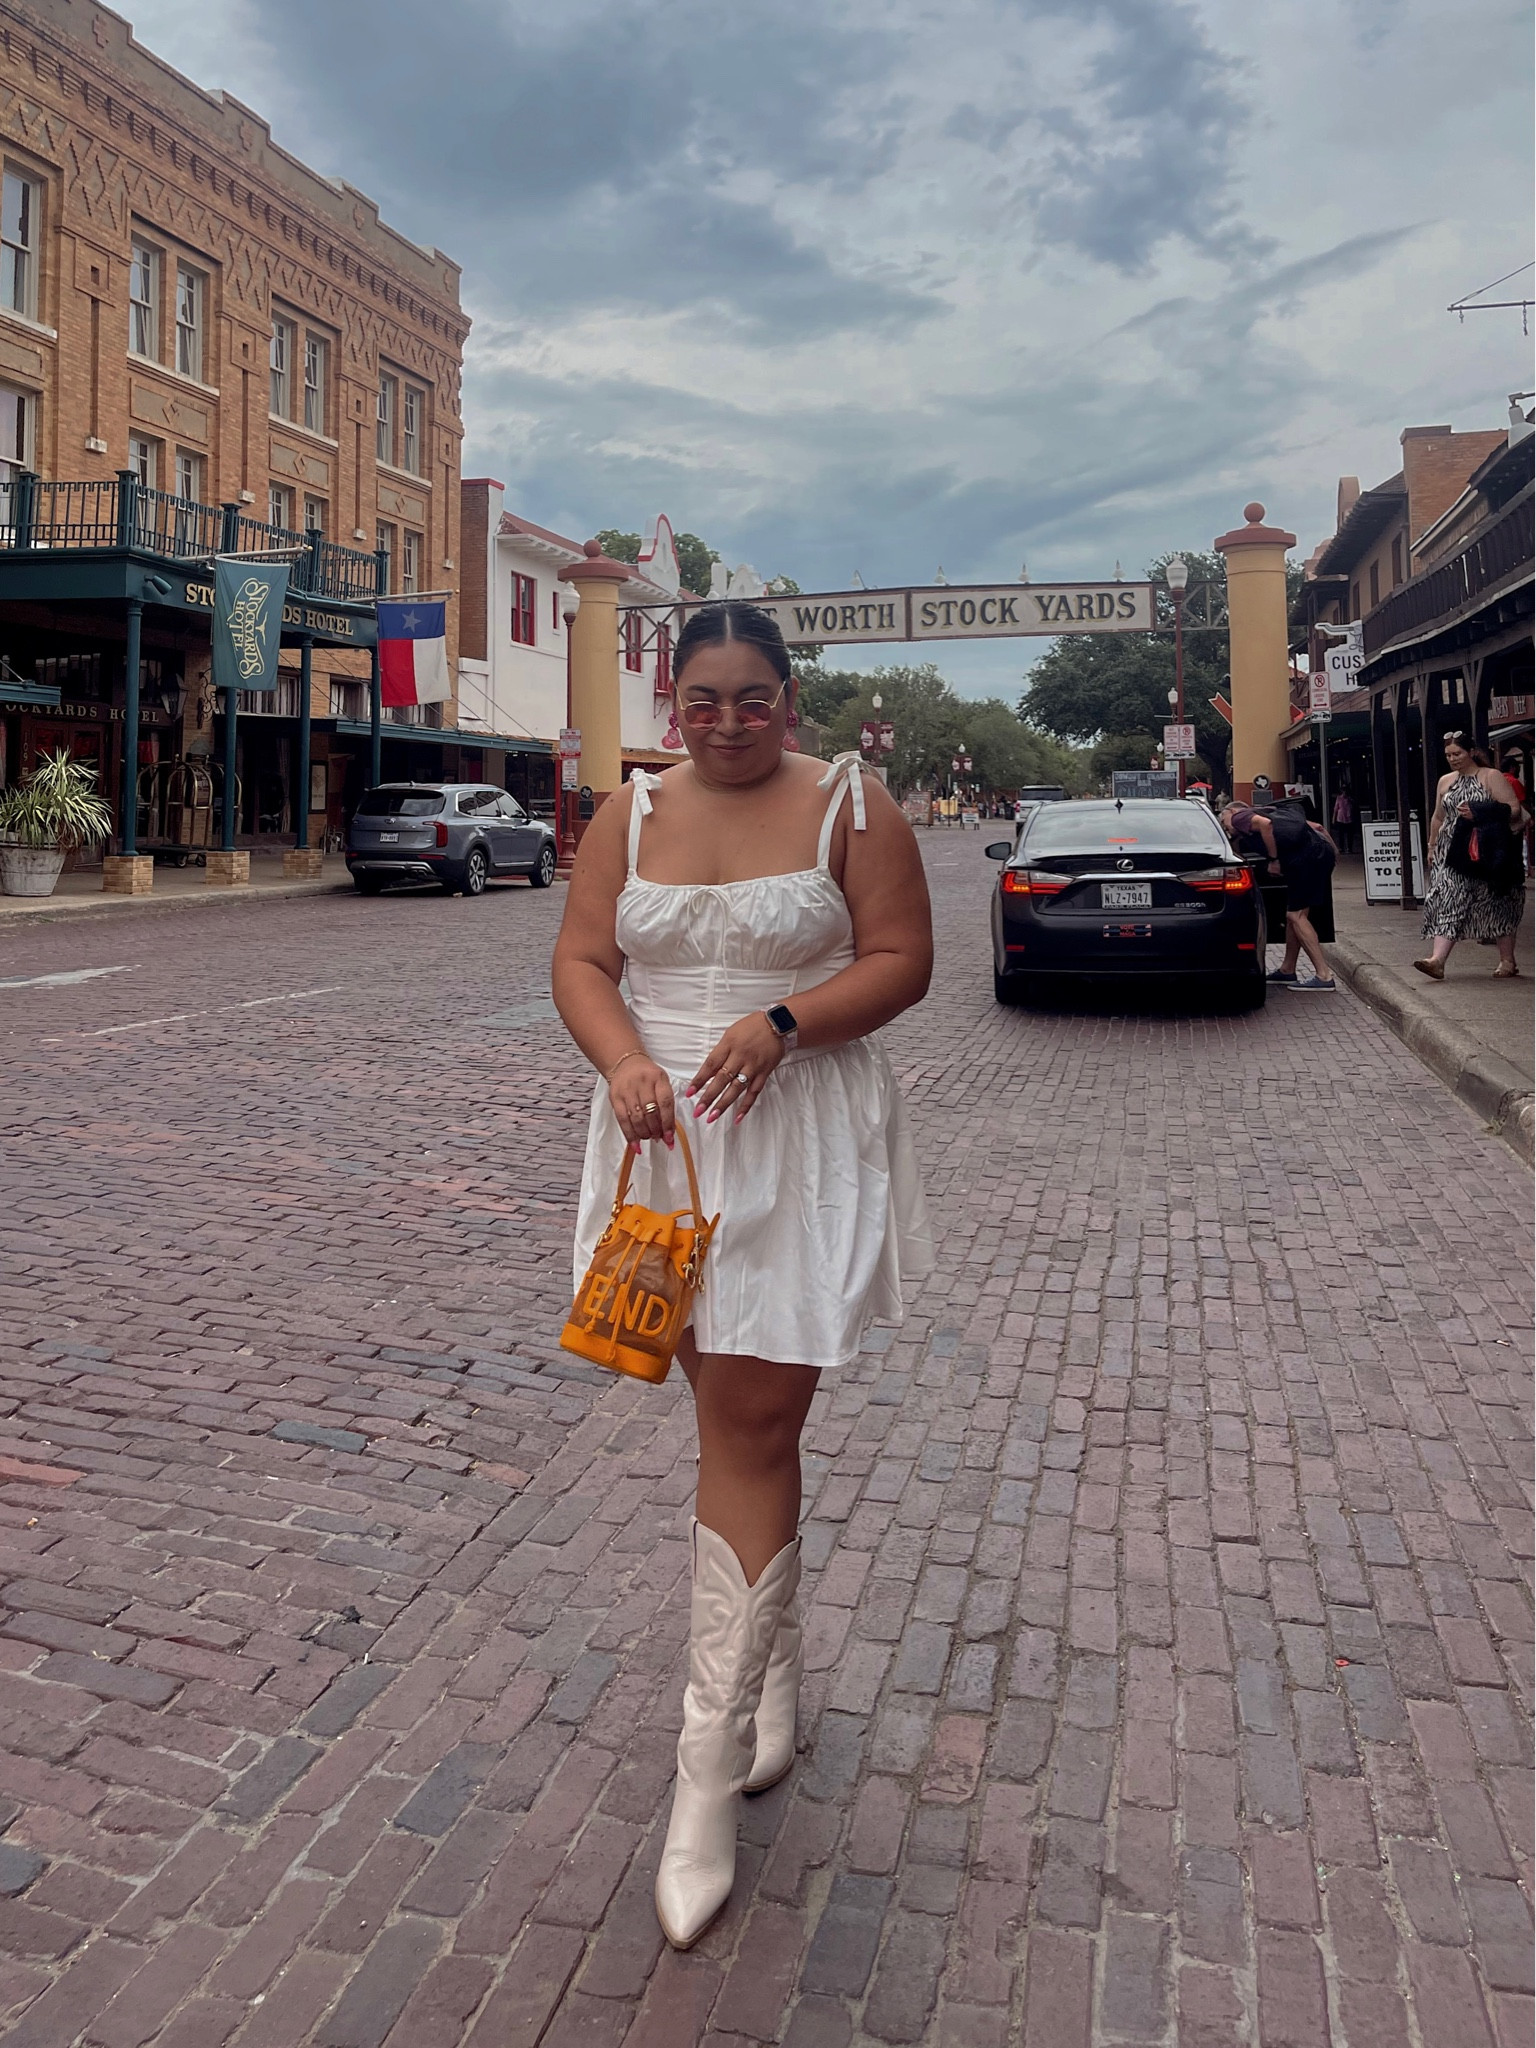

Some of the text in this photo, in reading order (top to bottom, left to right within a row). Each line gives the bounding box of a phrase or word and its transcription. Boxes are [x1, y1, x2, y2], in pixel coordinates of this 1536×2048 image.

[228, 600, 245, 651] HOTEL
[305, 609, 354, 636] HOTEL
[792, 603, 895, 633] WORTH
[920, 597, 1019, 627] STOCK
[1035, 591, 1136, 622] YARDS
[239, 581, 270, 676] STOCKYARDS
[1332, 655, 1364, 670] CUS
[110, 708, 160, 722] HOEL
[1375, 868, 1391, 876] TO
